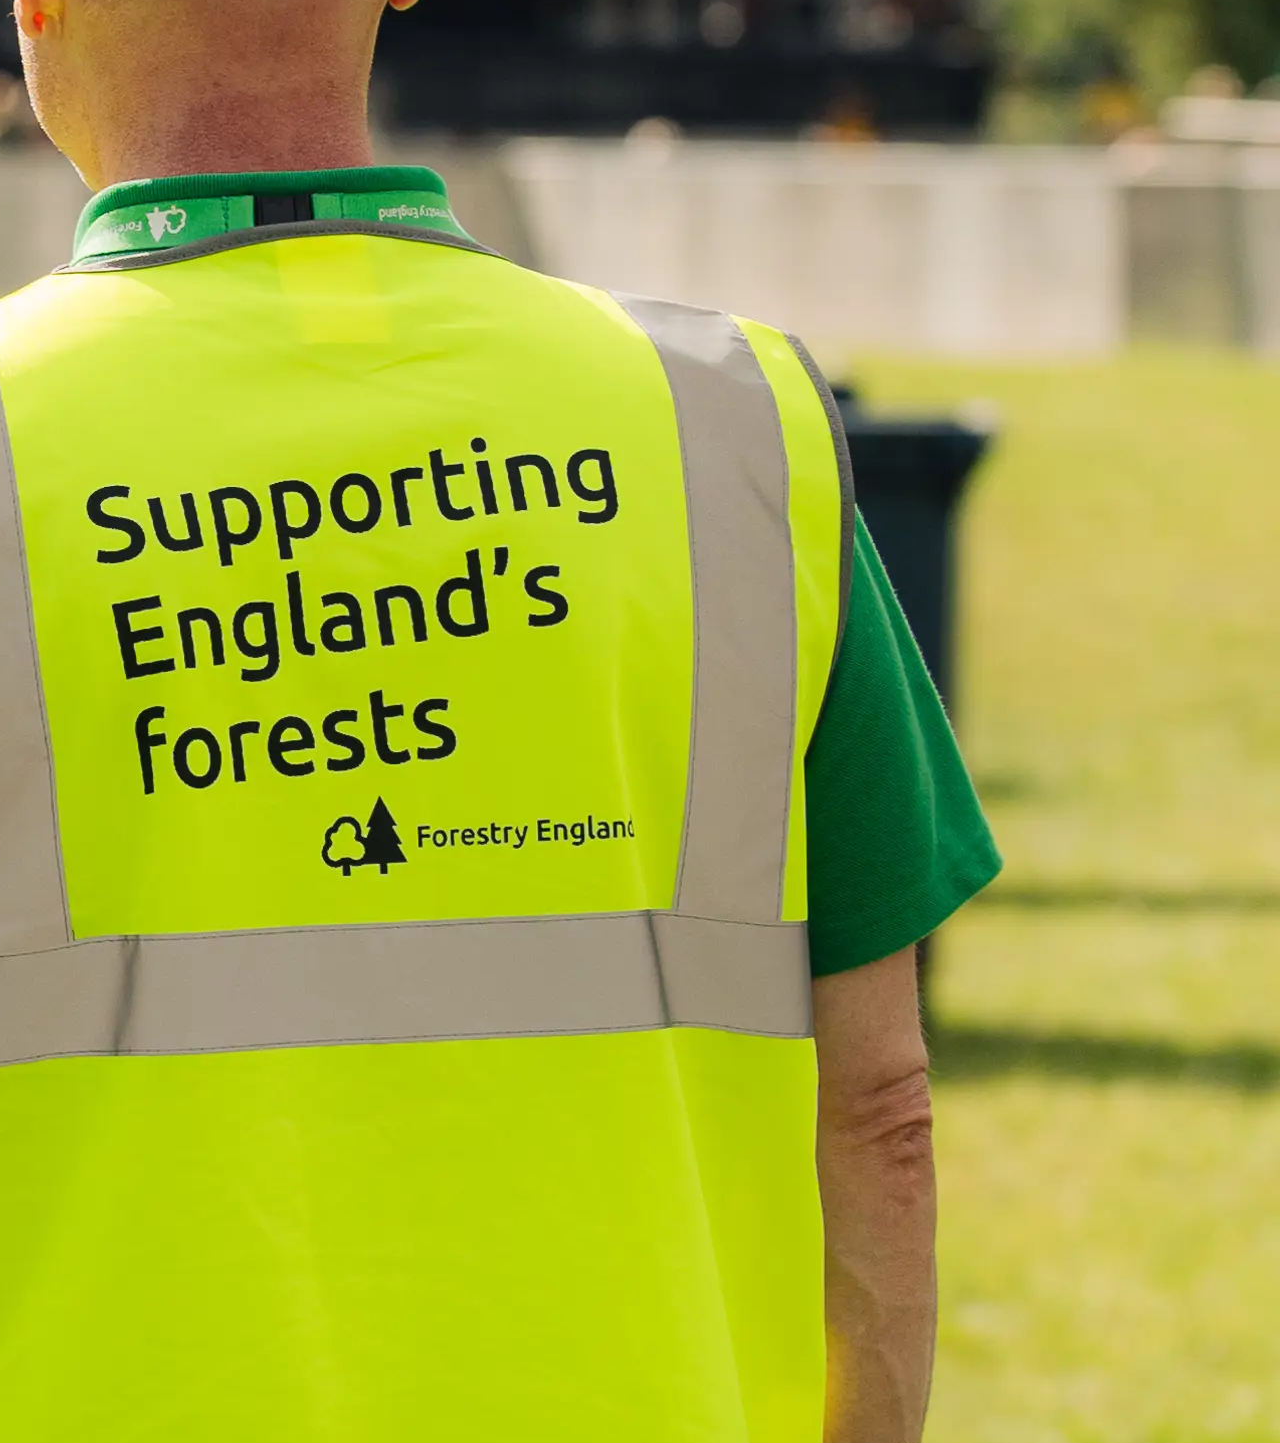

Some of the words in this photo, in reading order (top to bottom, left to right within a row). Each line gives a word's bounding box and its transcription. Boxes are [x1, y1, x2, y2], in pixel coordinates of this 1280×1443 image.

[378, 204, 420, 222] England
[86, 437, 619, 567] Supporting
[111, 546, 569, 683] England’s
[134, 689, 457, 795] forests
[416, 822, 528, 849] Forestry
